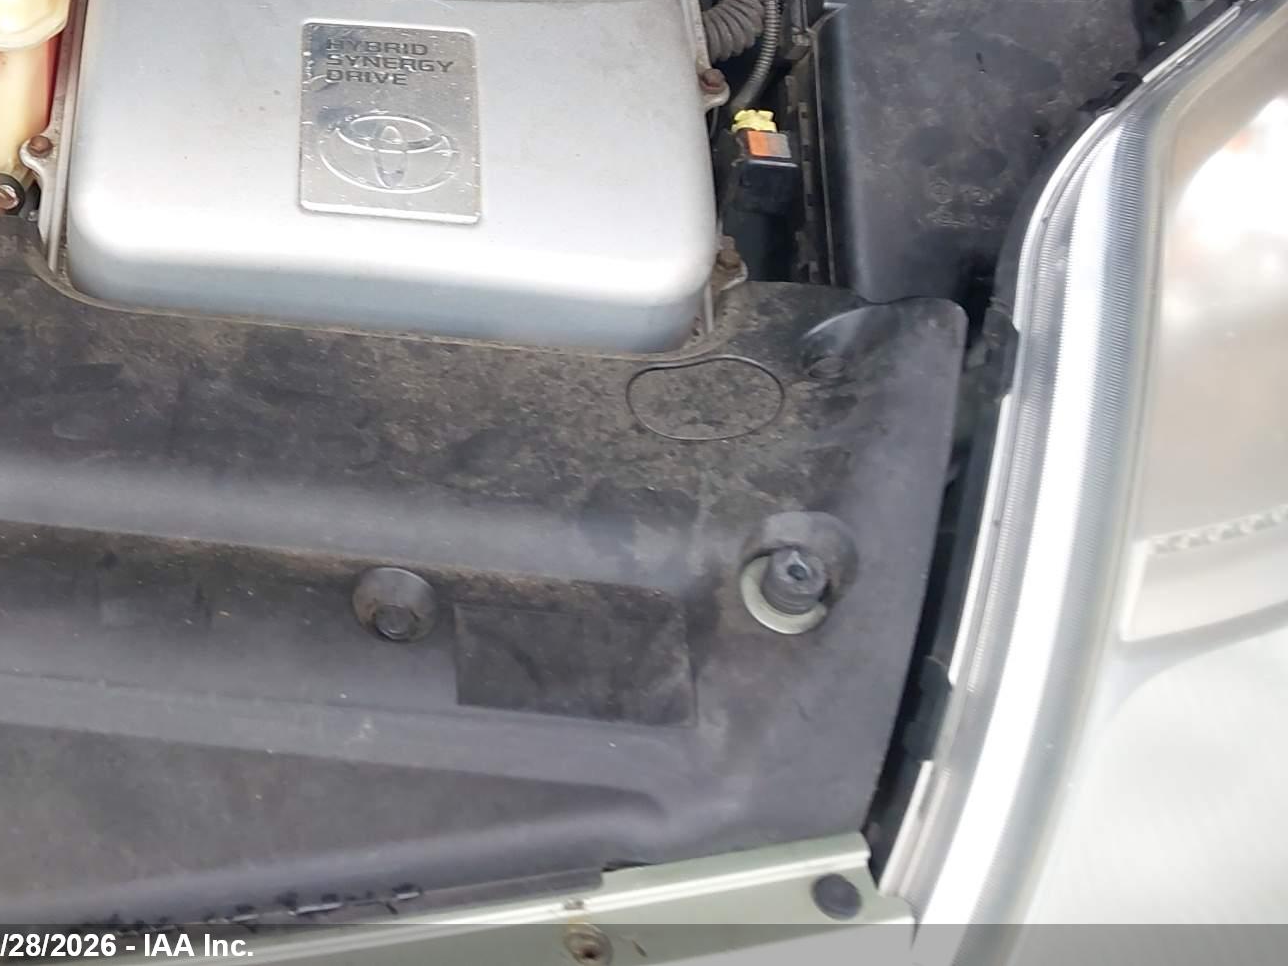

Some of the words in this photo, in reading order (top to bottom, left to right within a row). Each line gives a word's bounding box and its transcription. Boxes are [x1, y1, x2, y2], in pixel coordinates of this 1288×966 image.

[326, 37, 429, 56] HYBRID
[326, 53, 454, 73] SYNERGY
[326, 69, 409, 86] DRIVE
